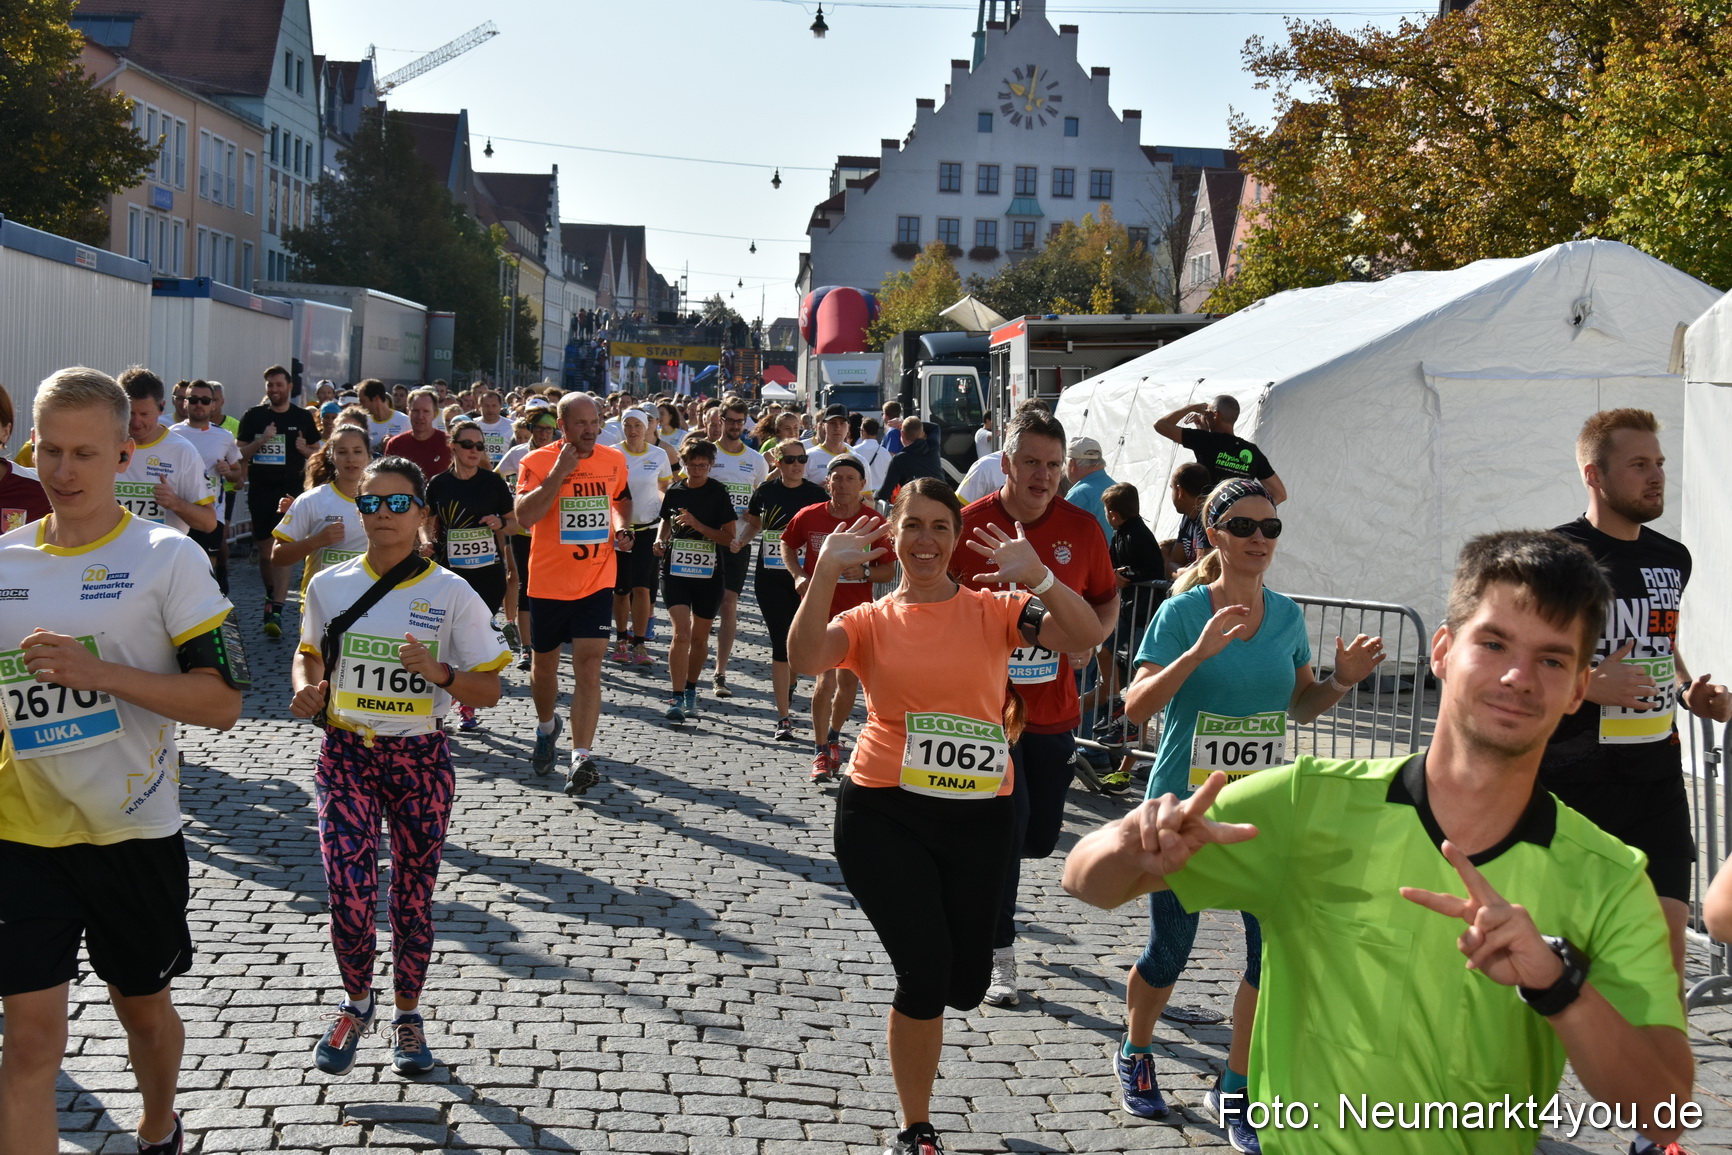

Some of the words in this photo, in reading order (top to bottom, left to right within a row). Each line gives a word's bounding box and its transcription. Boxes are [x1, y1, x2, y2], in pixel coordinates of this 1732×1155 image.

[646, 346, 685, 358] START
[1215, 459, 1250, 472] neumarkt
[116, 499, 159, 517] 173
[564, 498, 606, 510] BOCK
[566, 512, 606, 529] 2832
[450, 530, 489, 540] BOCK
[453, 540, 491, 556] 2593
[676, 541, 713, 551] BOCK
[464, 557, 481, 565] UTE
[675, 551, 711, 566] 2592
[84, 568, 107, 582] 20
[680, 566, 703, 575] MARIA
[1640, 567, 1682, 589] ROTH
[82, 581, 135, 591] Neumarkter
[0, 589, 29, 598] OCK
[80, 590, 122, 601] Stadtlauf
[1647, 588, 1679, 610] 2015
[411, 601, 429, 613] 20
[408, 619, 441, 632] Stadtlauf
[1008, 665, 1052, 677] ORSTEN
[352, 663, 427, 695] 1166
[356, 697, 415, 713] RENATA
[915, 716, 999, 739] BOCK
[1203, 716, 1280, 733] BOCK
[34, 722, 84, 745] LUKA
[918, 739, 996, 773] 1062
[1204, 740, 1275, 766] 1061
[927, 774, 977, 790] TANJA
